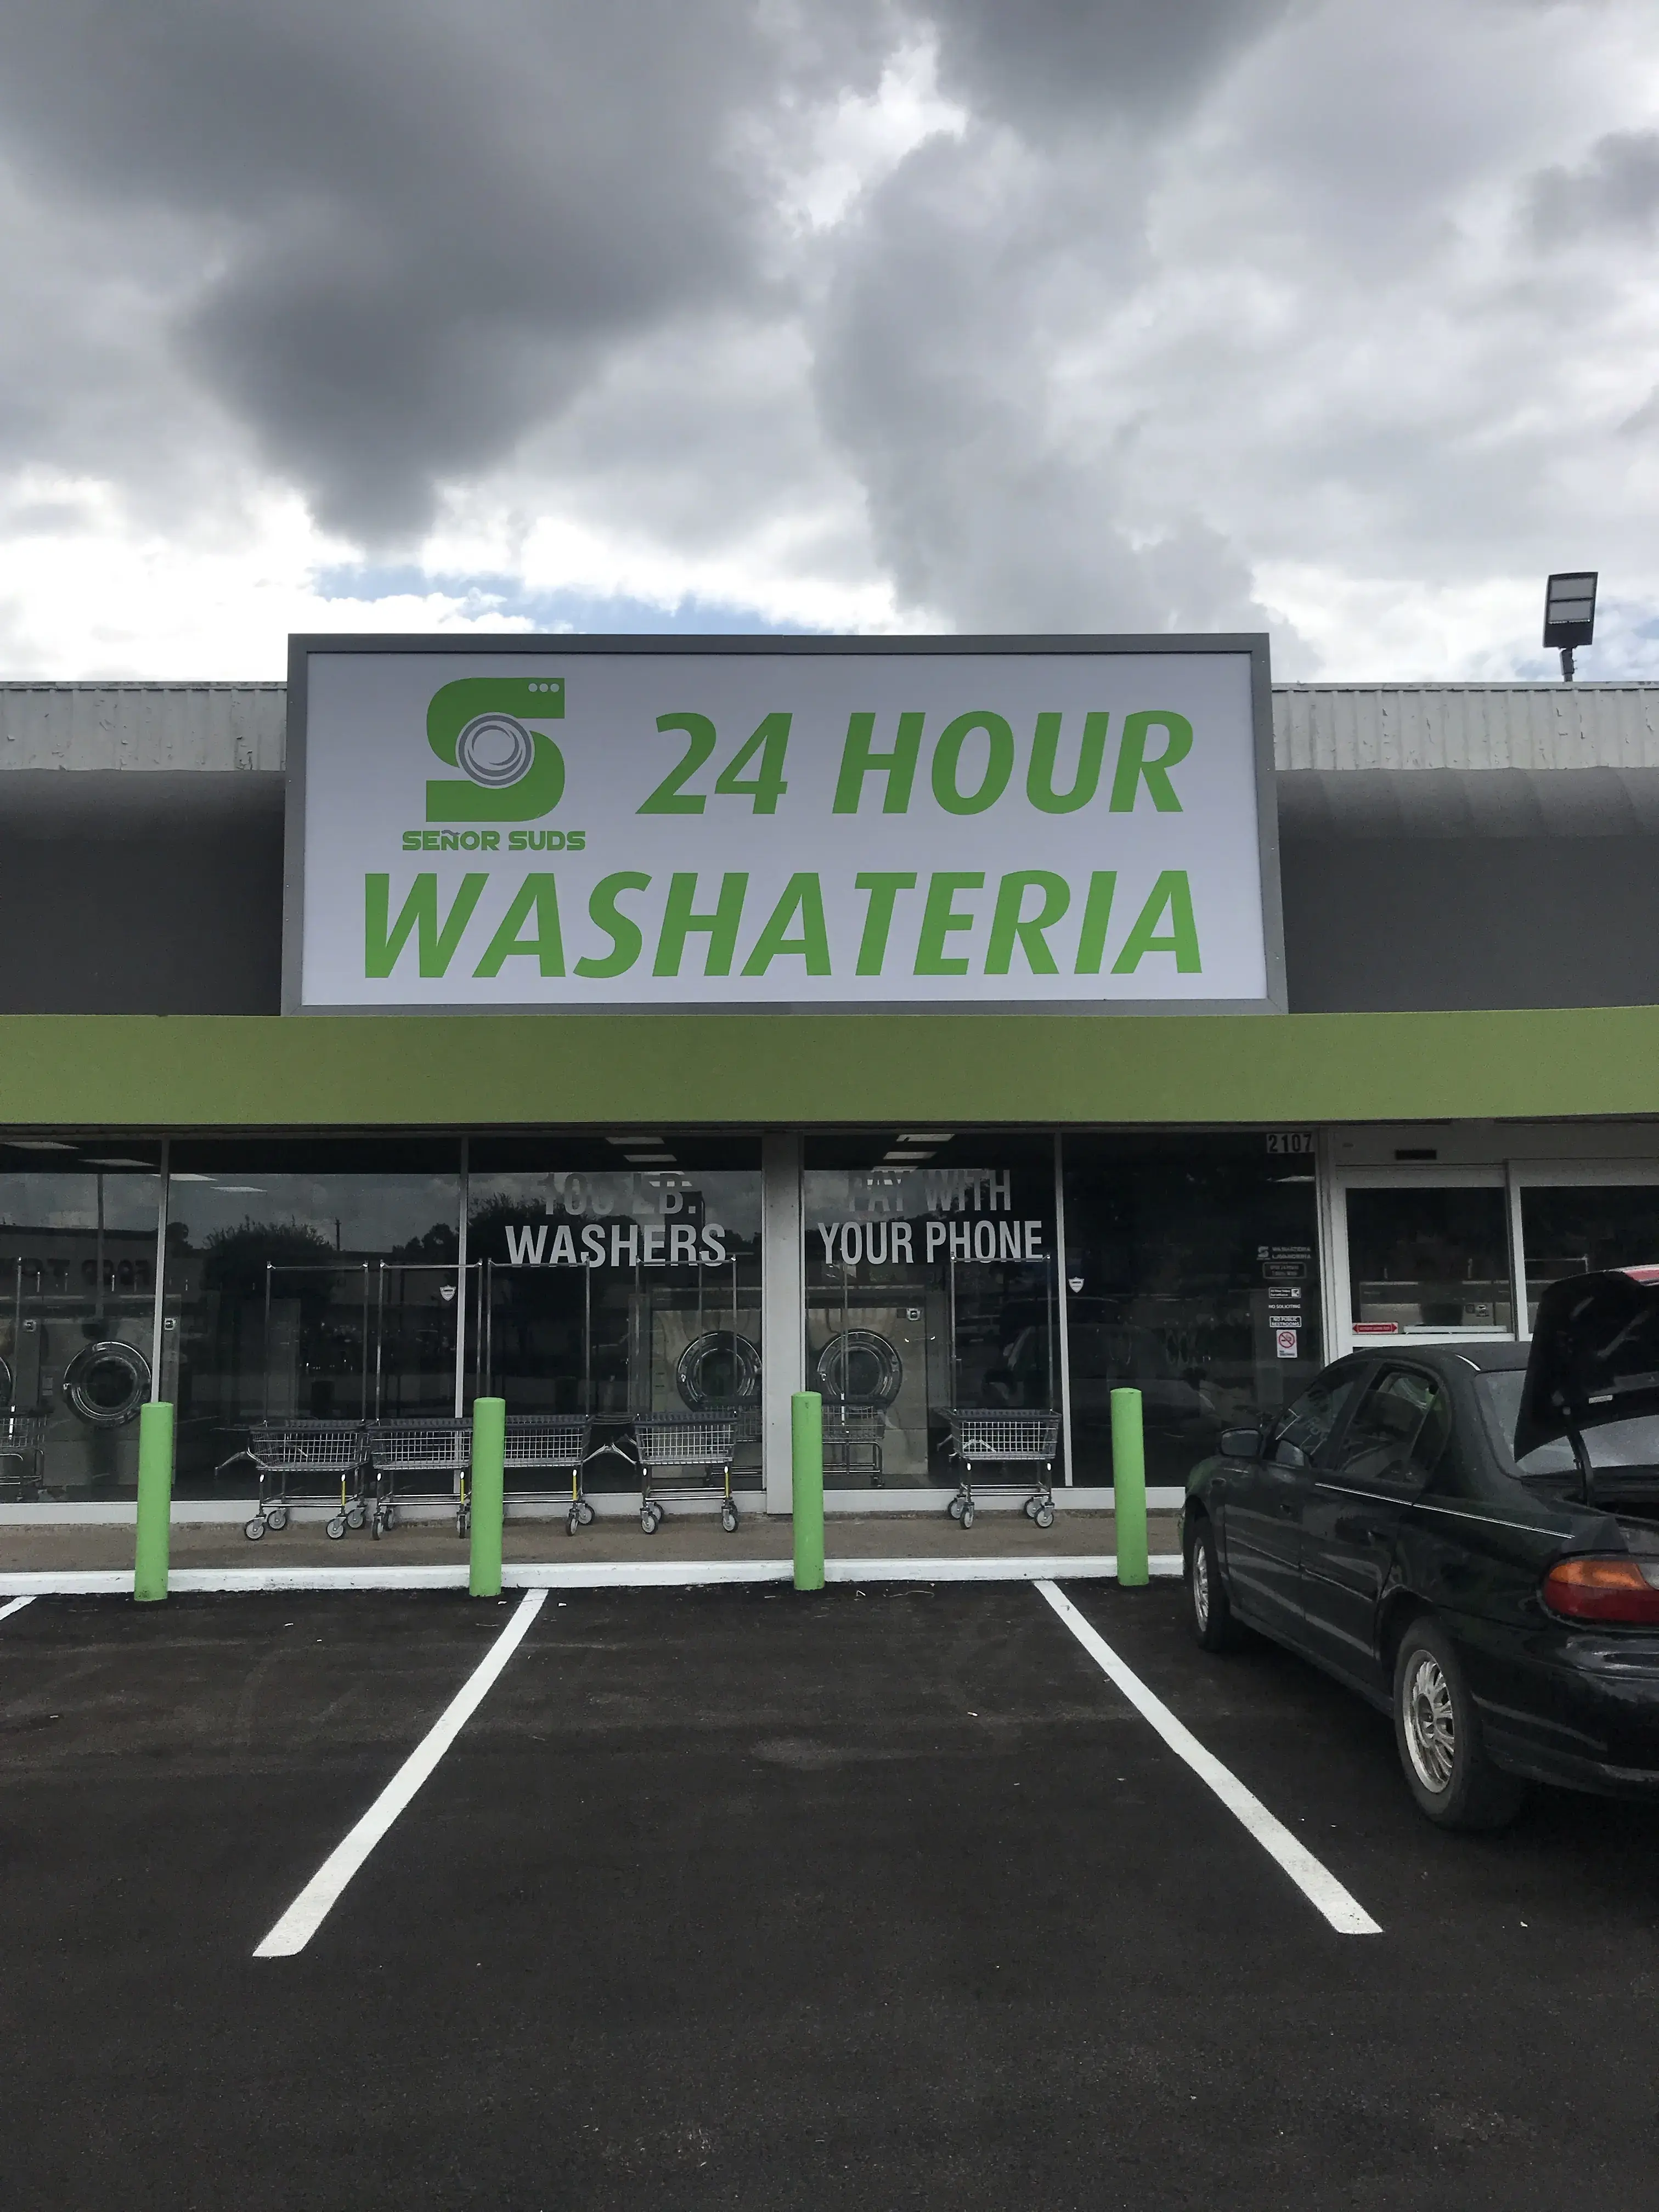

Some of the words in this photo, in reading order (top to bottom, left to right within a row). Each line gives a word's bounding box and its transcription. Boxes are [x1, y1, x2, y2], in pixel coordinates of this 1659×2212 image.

[636, 712, 793, 814] 24
[832, 710, 1193, 815] HOUR
[402, 830, 500, 851] SEÑOR
[508, 831, 586, 851] SUDS
[364, 871, 1203, 978] WASHATERIA
[1268, 1134, 1312, 1153] 2107
[848, 1170, 911, 1212] PAY
[923, 1169, 1012, 1211] WITH
[505, 1223, 726, 1268] WASHERS
[817, 1221, 915, 1265] YOUR
[926, 1220, 1044, 1264] PHONE
